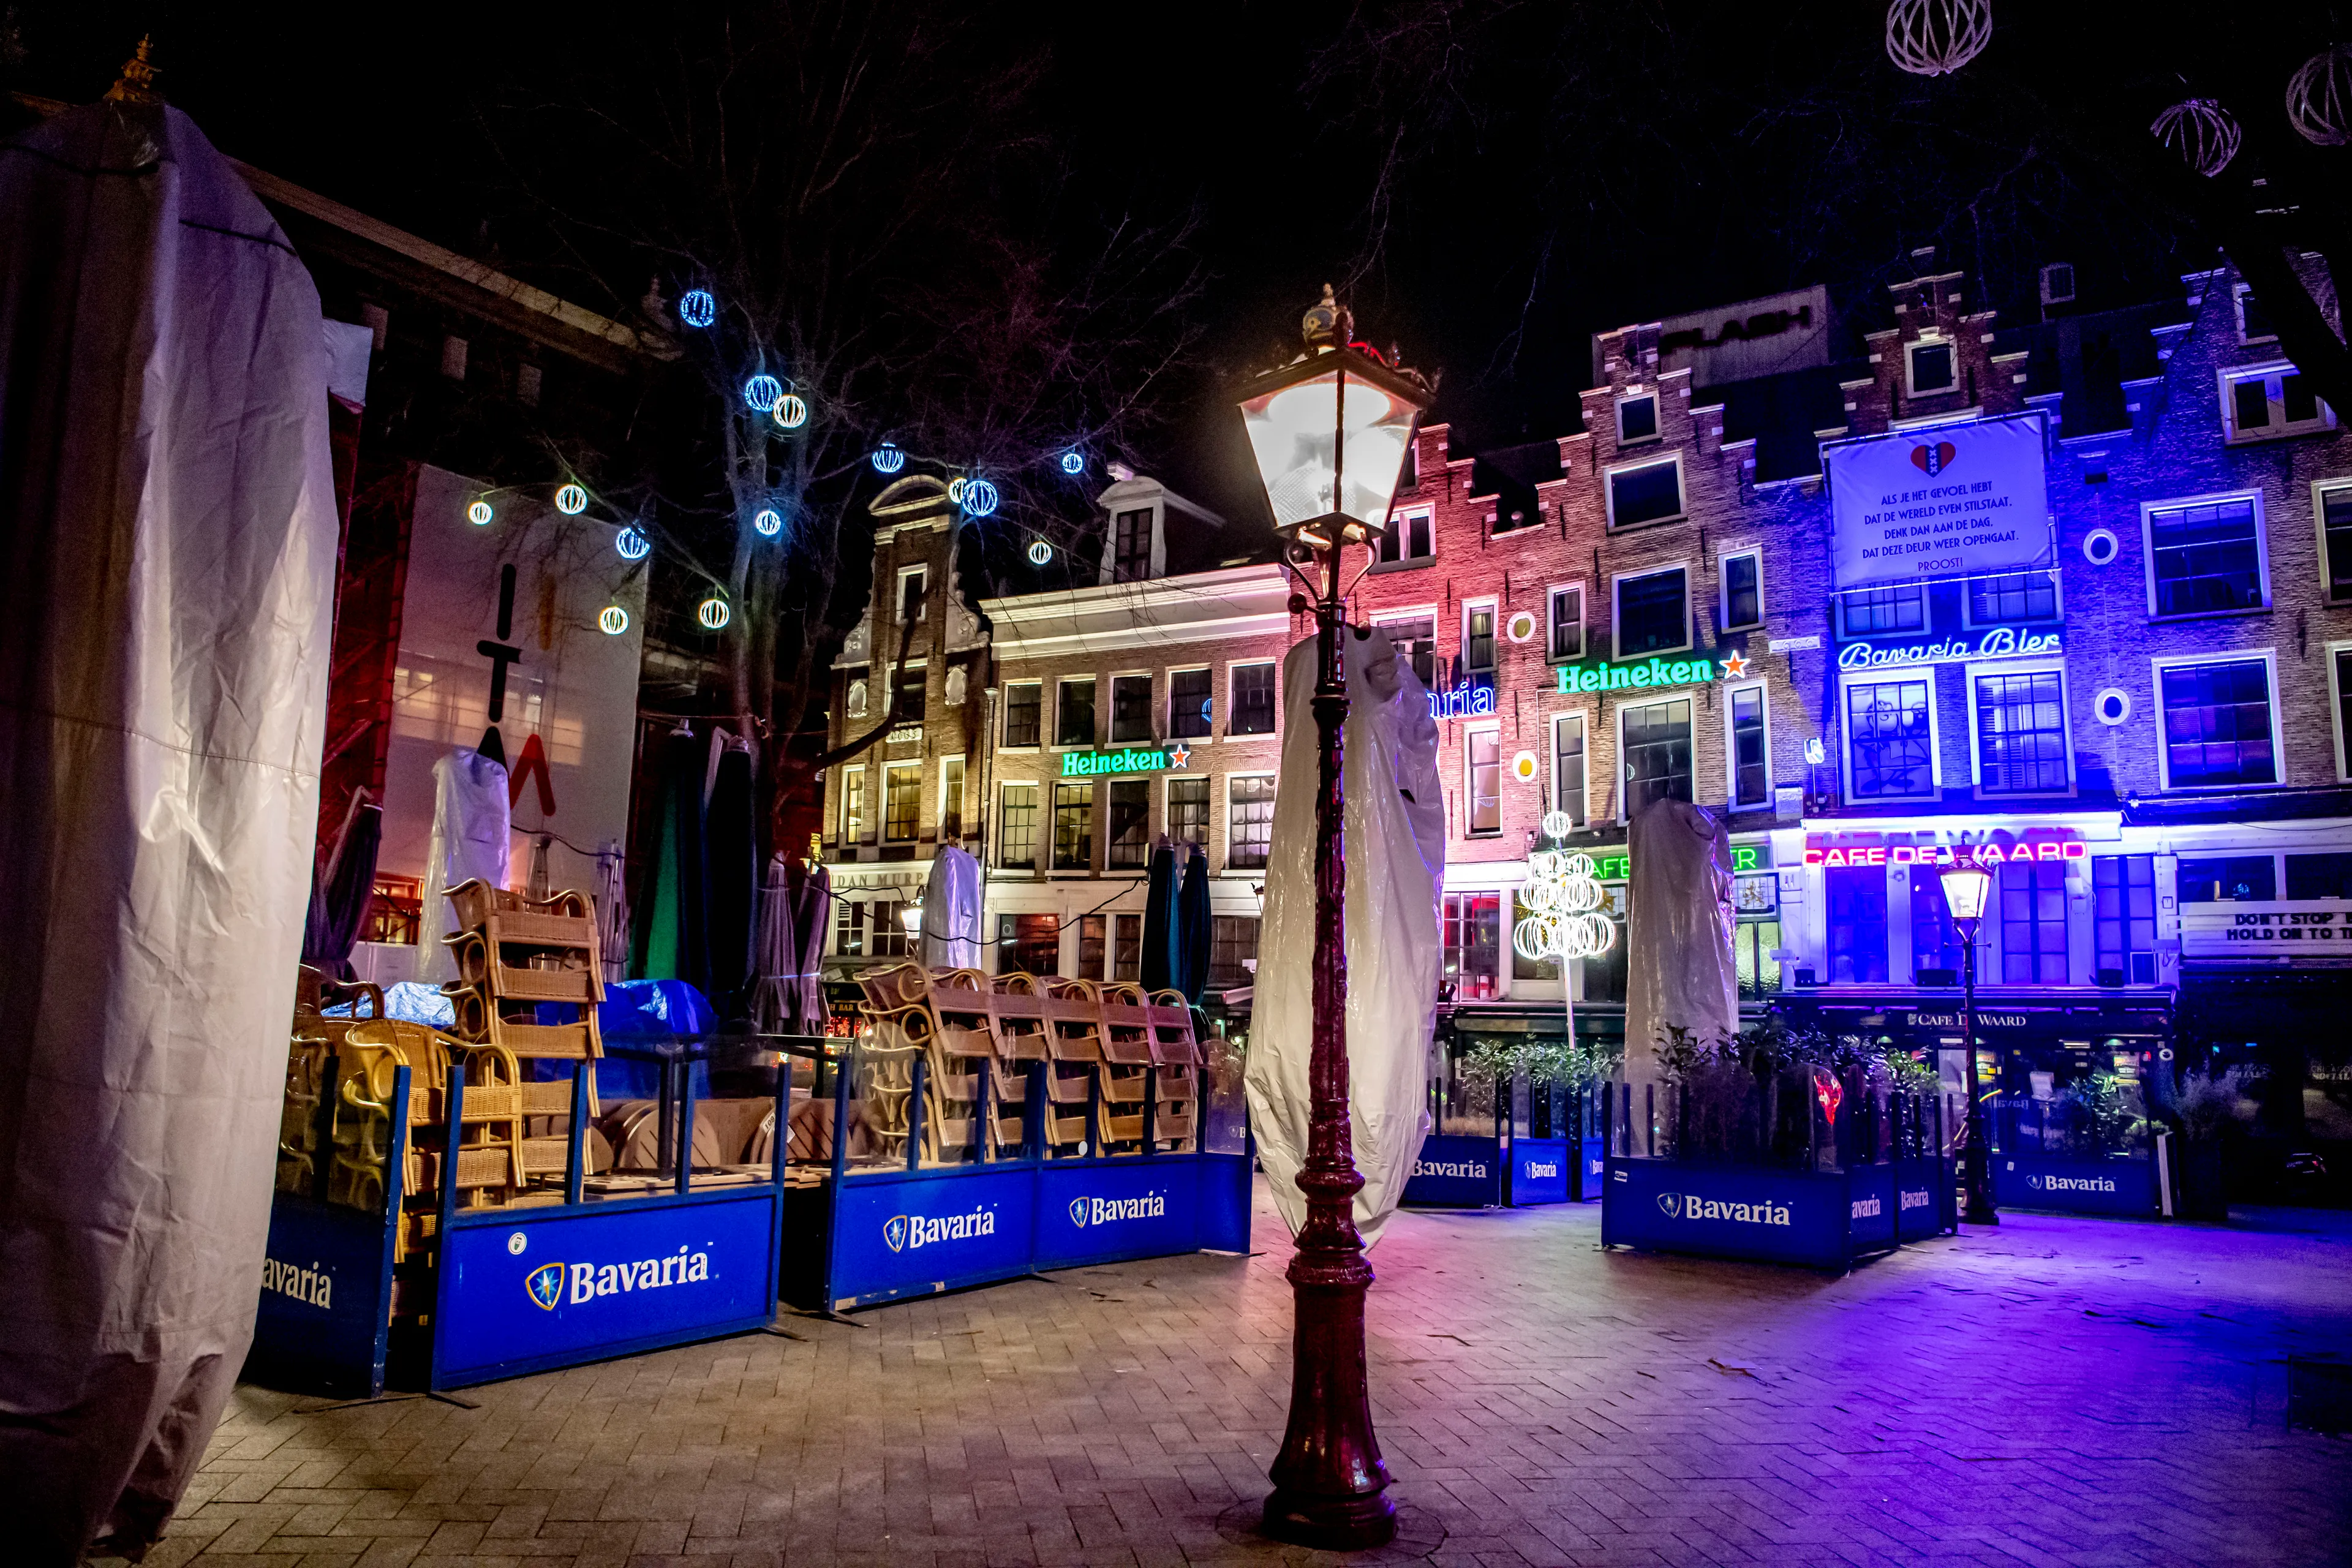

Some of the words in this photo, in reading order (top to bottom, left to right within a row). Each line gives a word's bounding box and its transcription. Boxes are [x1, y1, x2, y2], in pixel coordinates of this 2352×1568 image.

[1882, 494, 1898, 505] ALS
[1901, 492, 1910, 503] JE
[1912, 490, 1928, 501] HET
[1931, 484, 1969, 499] GEVOEL
[1971, 481, 1992, 493] HEBT
[1864, 513, 1881, 524] DAT
[1884, 511, 1896, 522] DE
[1898, 507, 1936, 519] WERELD
[1939, 502, 1961, 515] EVEN
[1885, 527, 1908, 540] DENK
[1910, 524, 1930, 537] DAN
[1933, 521, 1953, 533] AAN
[1956, 519, 1968, 530] DE
[1863, 548, 1879, 559] DAT
[1882, 545, 1903, 556] DEZE
[1906, 541, 1931, 553] DEUR
[1934, 538, 1960, 549] WEER
[1963, 530, 2019, 546] OPENGAAT.
[1838, 636, 1971, 669] Bavaria
[1556, 658, 1714, 694] Heineken
[1061, 748, 1166, 776] Heineken
[1589, 856, 1630, 879] AFE
[1801, 846, 1887, 866] CAFE
[1893, 846, 1938, 865] DE
[838, 875, 867, 888] DAN
[877, 872, 924, 886] MURP
[2291, 912, 2334, 925] STOP
[2226, 927, 2274, 940] HOLD
[2279, 927, 2302, 940] ON
[2308, 927, 2332, 940] TO
[1977, 1014, 2026, 1026] WAARD
[764, 1116, 775, 1129] 109
[1411, 1159, 1487, 1178] Bavaria
[1531, 1160, 1556, 1178] Bavaria
[2045, 1176, 2116, 1192] Bavaria
[1091, 1191, 1164, 1226] Bavaria
[1852, 1194, 1880, 1219] avaria
[1901, 1186, 1929, 1211] Bavaria
[1685, 1196, 1790, 1226] Bavaria
[909, 1205, 995, 1249] Bavaria
[262, 1258, 331, 1310] avaria
[570, 1245, 708, 1305] Bavaria
